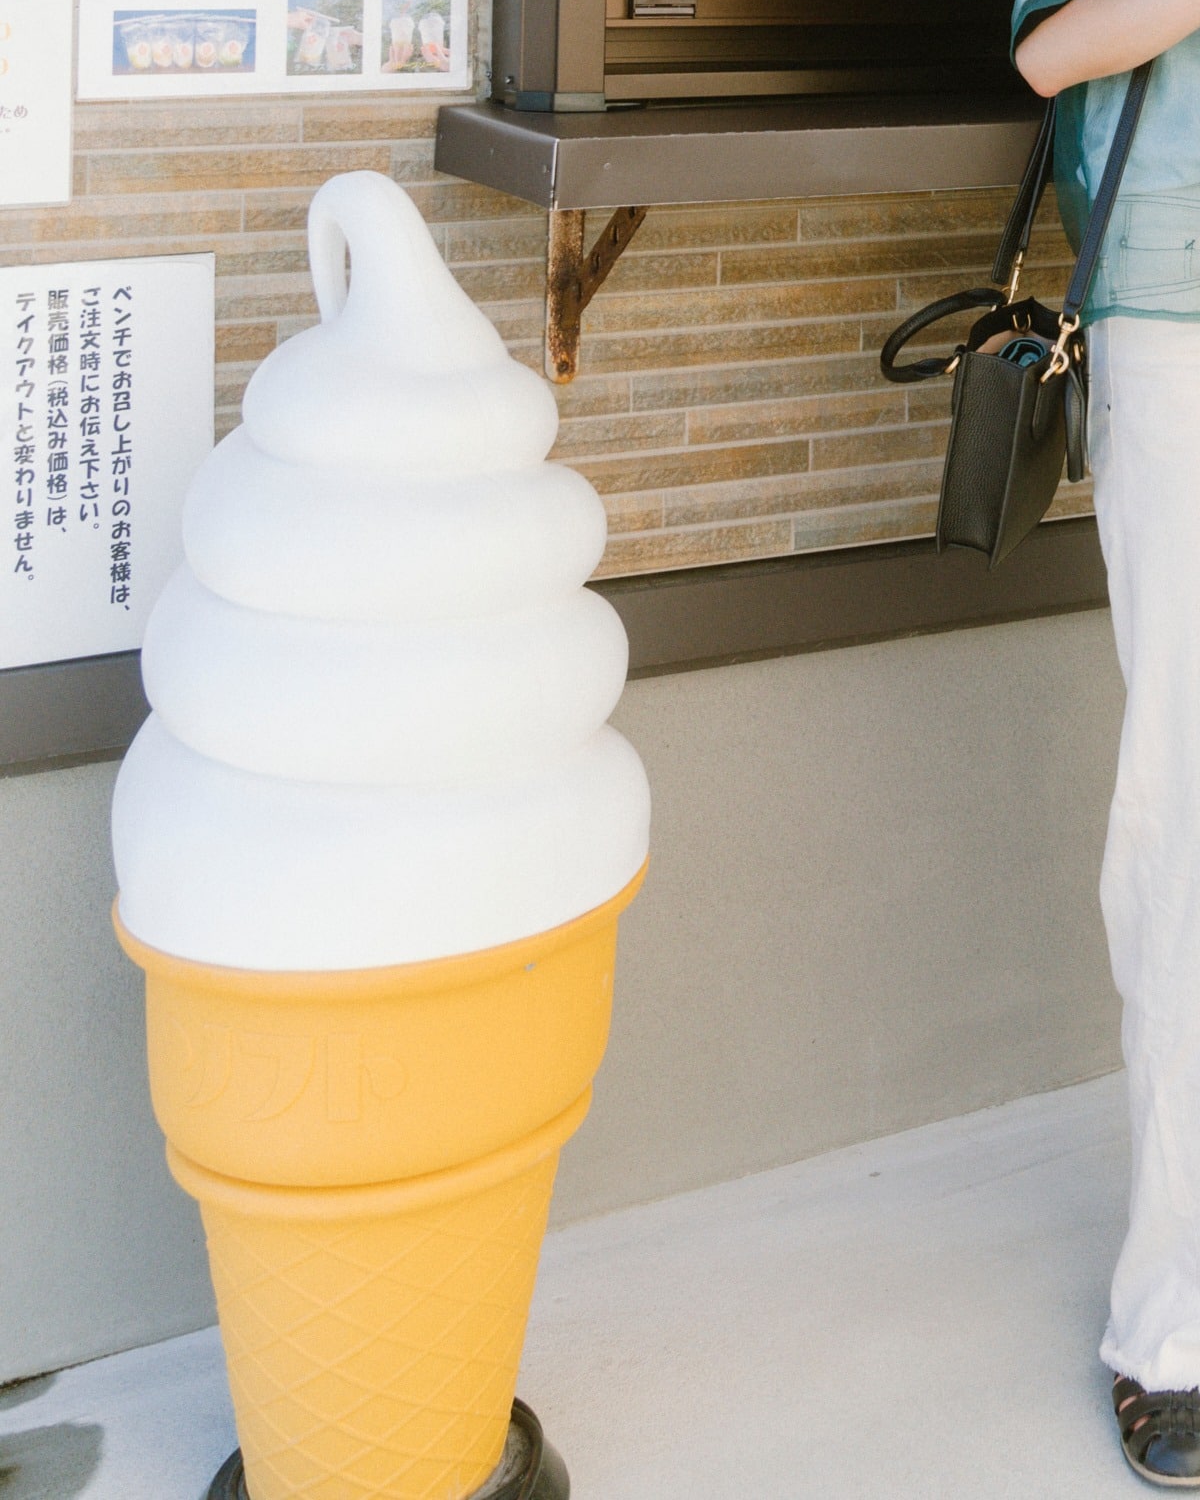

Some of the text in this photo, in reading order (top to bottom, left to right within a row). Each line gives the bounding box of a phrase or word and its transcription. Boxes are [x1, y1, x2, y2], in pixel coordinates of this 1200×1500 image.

[13, 291, 36, 582] テイクアウトと変わりません。
[46, 289, 69, 533] 販売価格(税込み価格)は、
[79, 286, 101, 531] ご注文時にお伝え下さい。
[110, 285, 132, 611] ベンチでお召し上がりのお客様は、
[170, 1024, 410, 1124] ソフト
